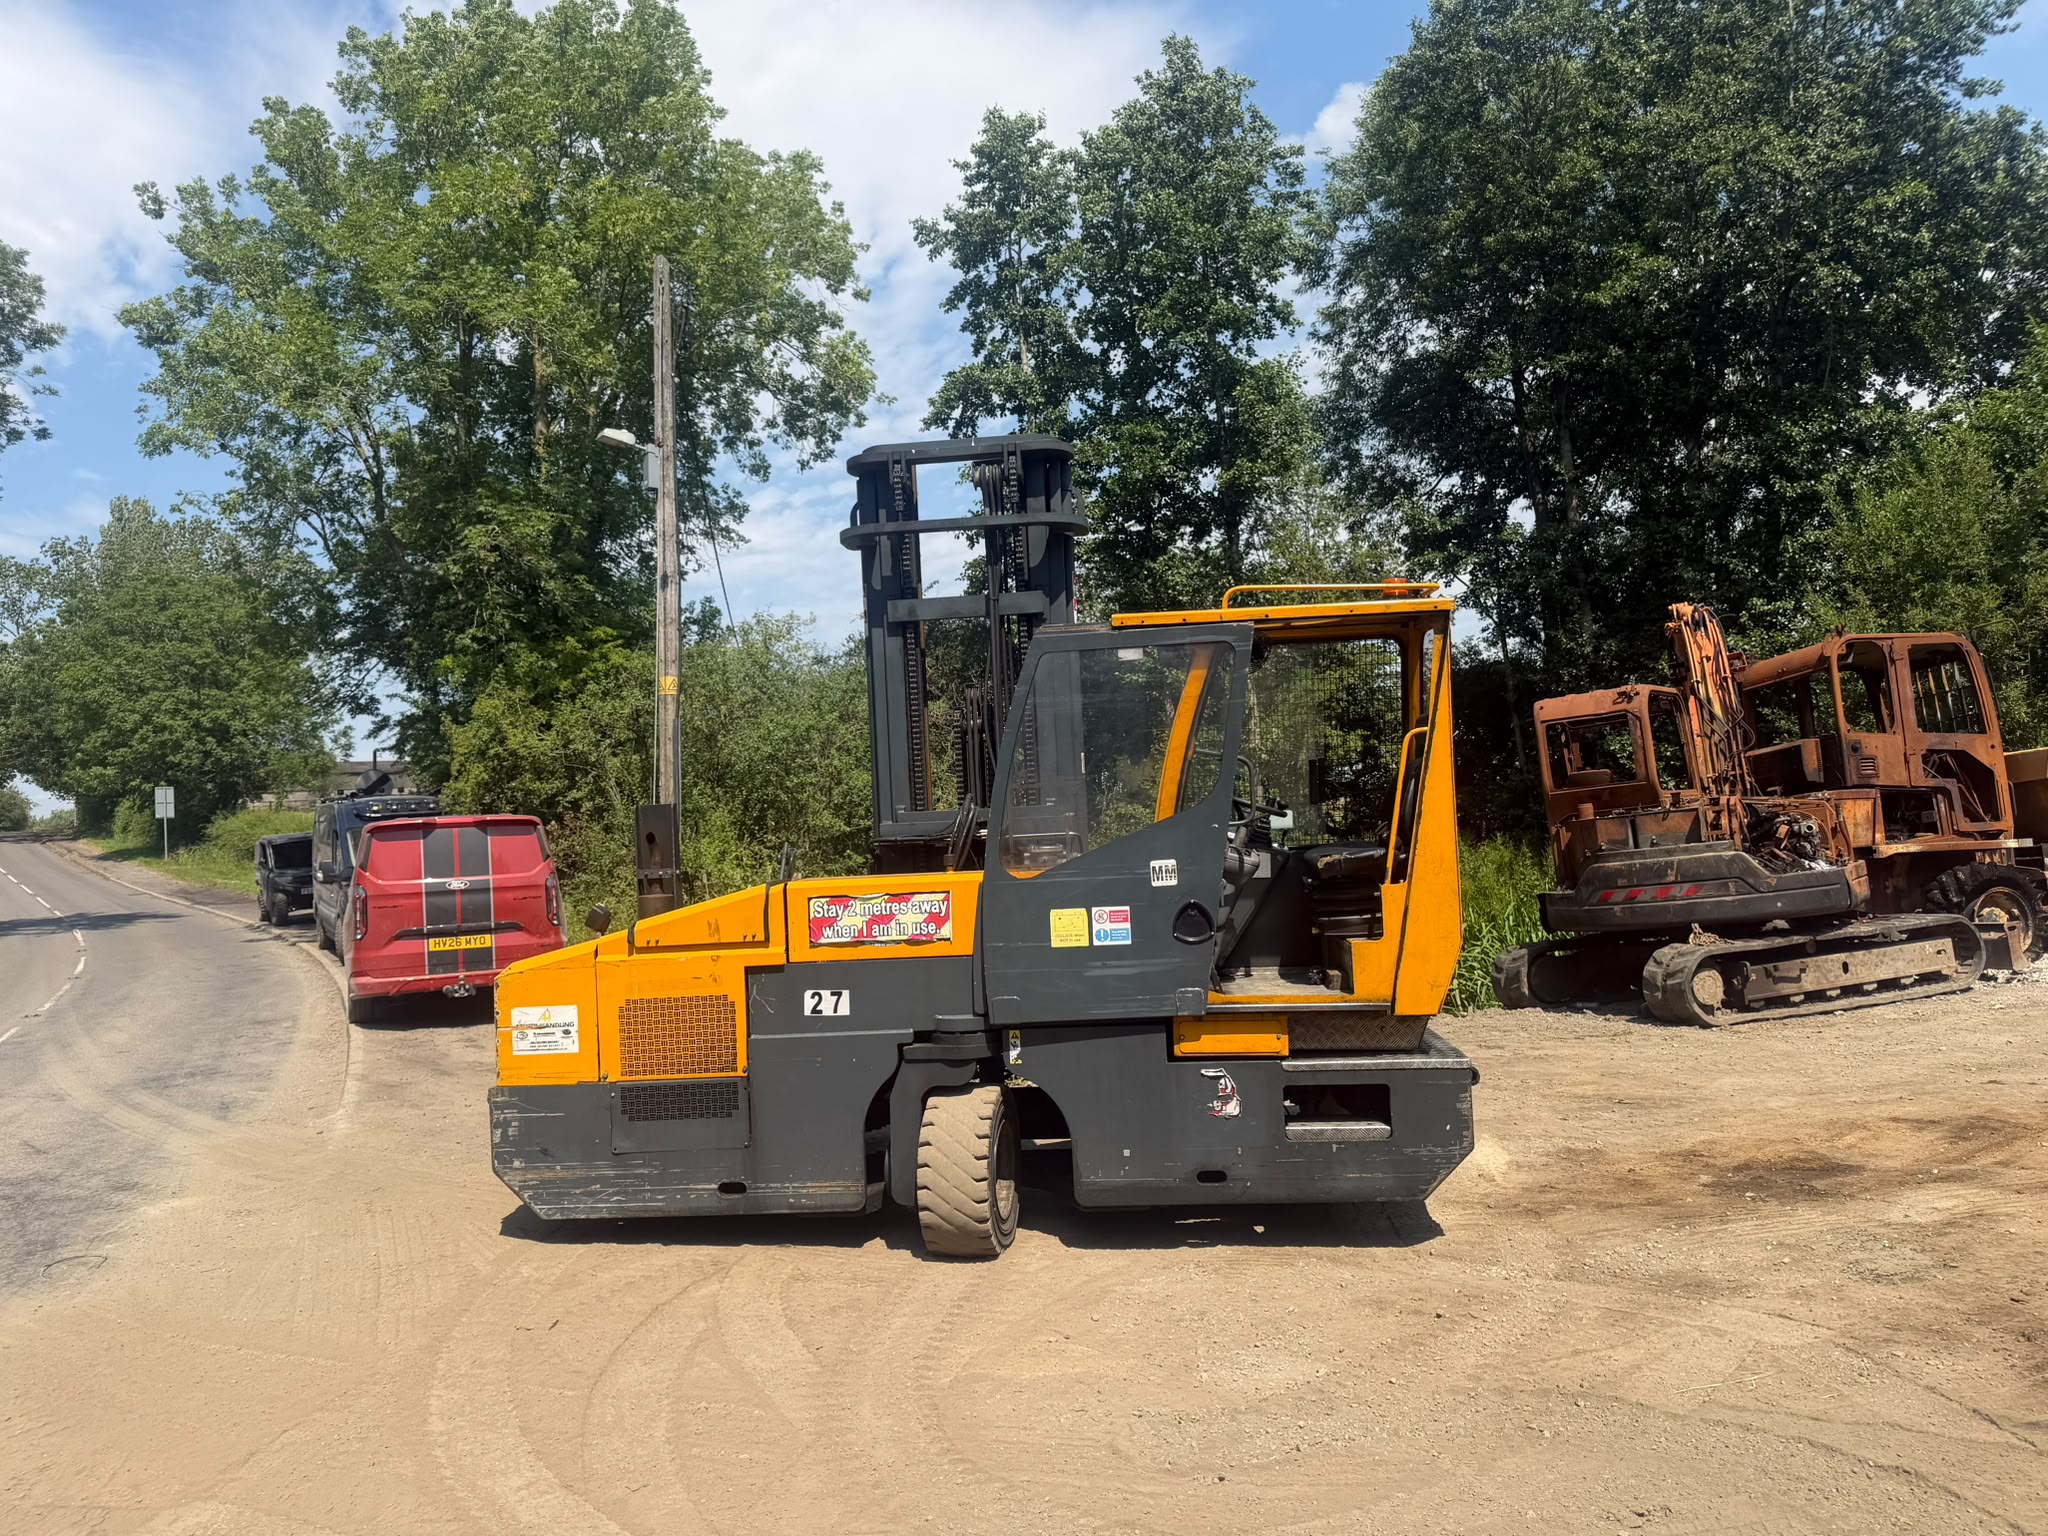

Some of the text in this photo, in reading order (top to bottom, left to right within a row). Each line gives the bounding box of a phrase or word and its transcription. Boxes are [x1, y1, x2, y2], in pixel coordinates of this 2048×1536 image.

[813, 898, 947, 920] Stay 2 metres away
[822, 919, 940, 938] when I am in use.
[433, 936, 486, 949] HV26 MYO
[810, 991, 843, 1015] 27
